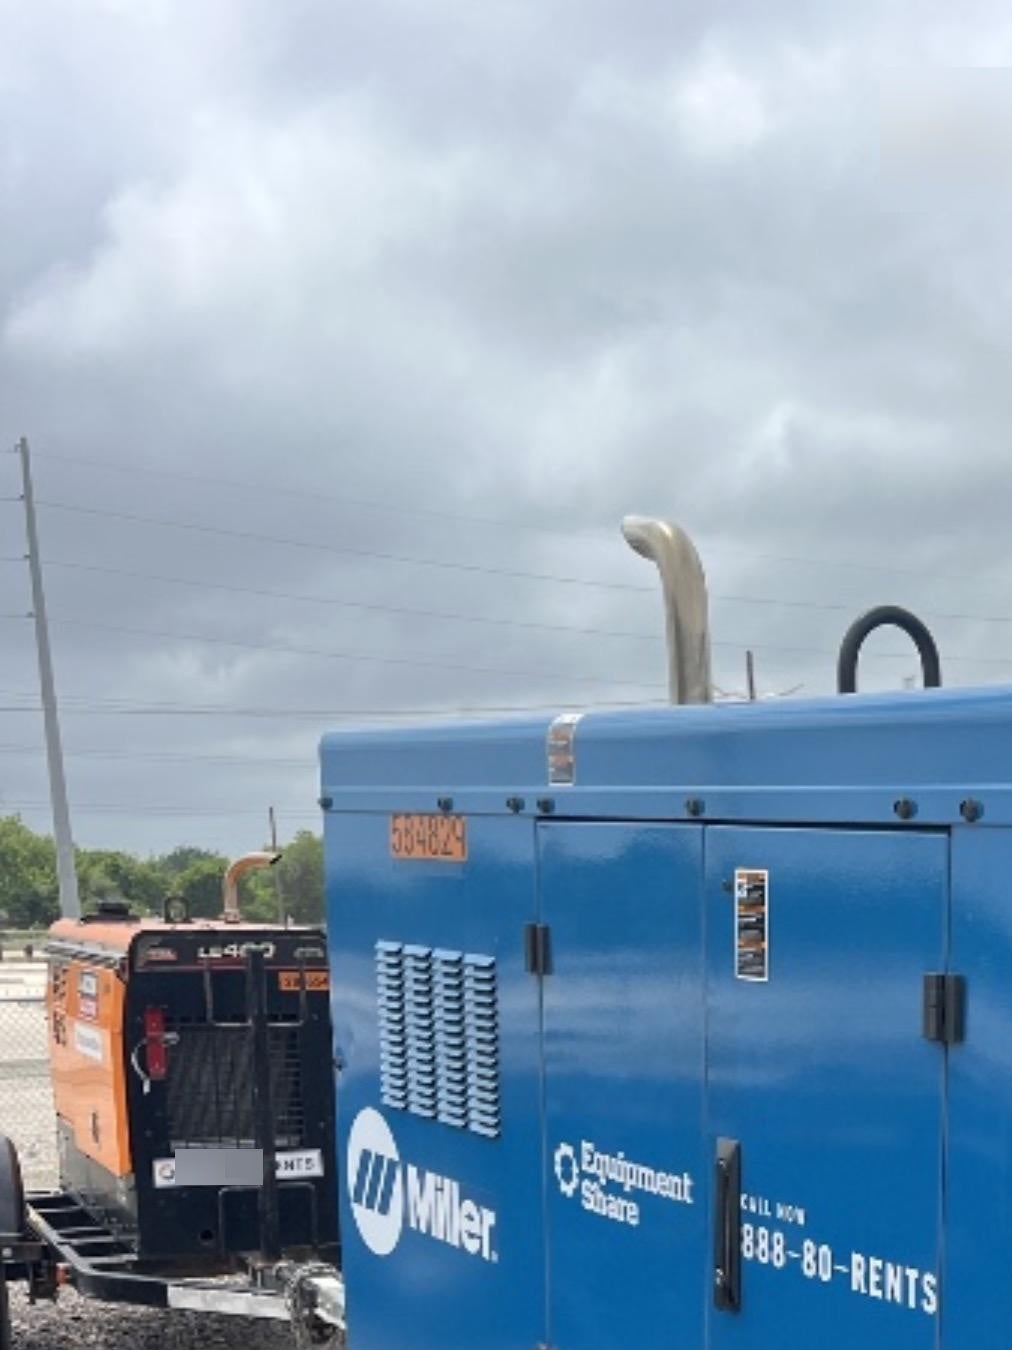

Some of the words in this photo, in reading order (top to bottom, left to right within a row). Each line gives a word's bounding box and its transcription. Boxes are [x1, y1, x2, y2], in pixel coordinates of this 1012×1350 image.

[580, 1139, 694, 1205] Equipment
[580, 1178, 641, 1226] Share
[407, 1163, 496, 1261] Miller
[740, 1193, 772, 1217] CALL
[776, 1202, 806, 1226] NOW
[740, 1223, 938, 1315] 888-80-RENTS
